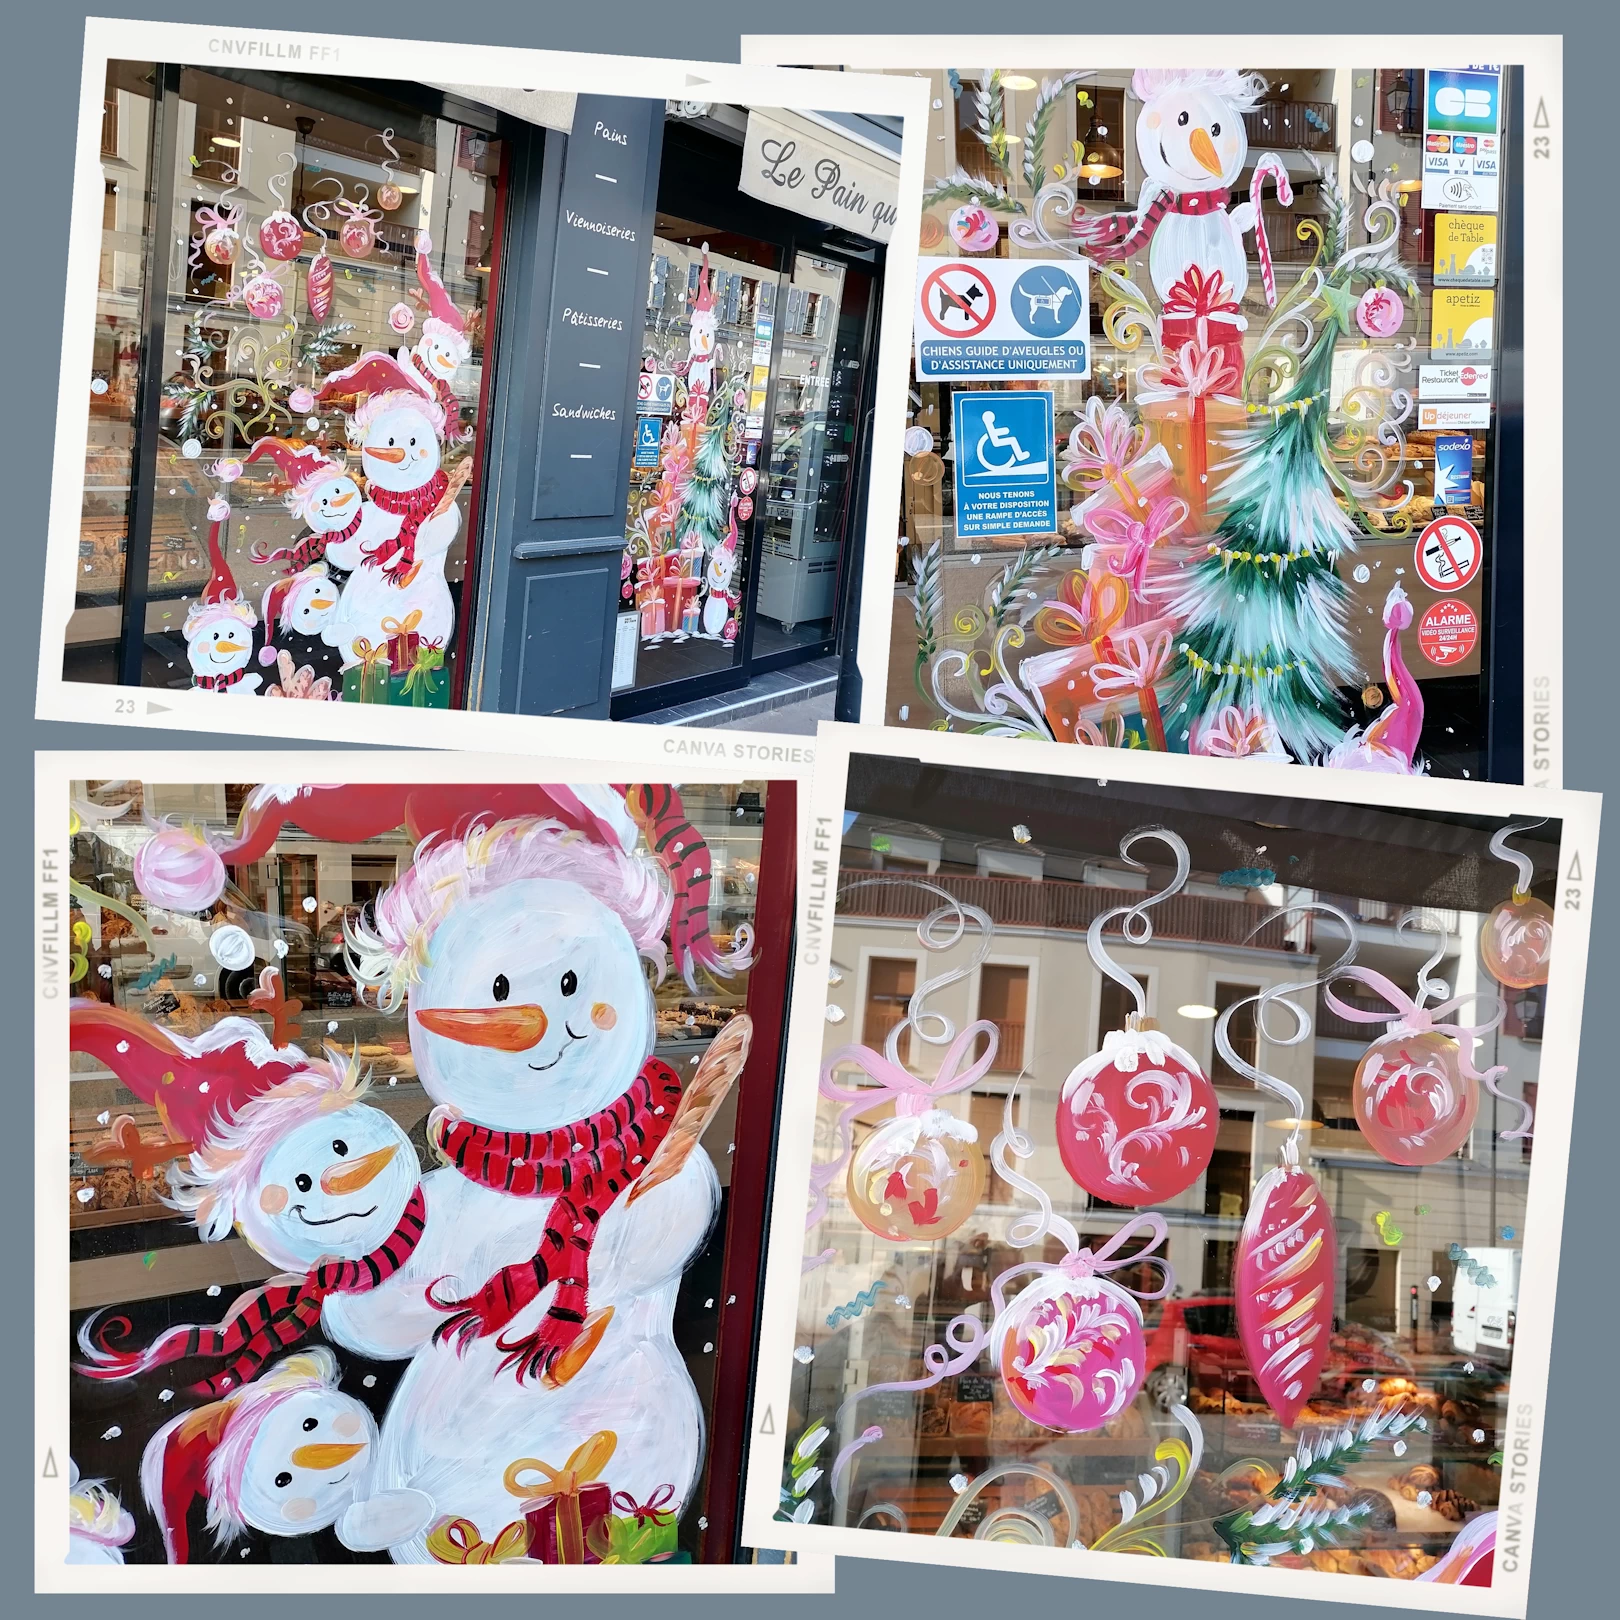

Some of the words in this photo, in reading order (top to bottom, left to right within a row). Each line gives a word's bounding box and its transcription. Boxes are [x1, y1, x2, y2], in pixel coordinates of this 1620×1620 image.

[594, 121, 628, 146] Pains
[1428, 157, 1449, 167] VISA
[1476, 159, 1497, 170] VISA
[761, 138, 806, 189] Le
[811, 158, 869, 215] Pain
[566, 209, 636, 242] Viennoiseries
[1448, 218, 1485, 233] chèque
[1448, 231, 1459, 242] de
[1460, 232, 1484, 243] Table
[1446, 293, 1481, 307] apetiz
[562, 307, 623, 331] Pâtisseries
[922, 345, 962, 357] CHIENS
[965, 345, 999, 356] GUIDE
[1002, 345, 1066, 356] D'AVEUGLES
[1068, 346, 1084, 356] OU
[931, 359, 1005, 371] D'ASSISTANCE
[1008, 359, 1077, 371] UNIQUEMENT
[1440, 369, 1459, 377] Ticket
[1459, 372, 1489, 380] Edenred
[1421, 376, 1459, 384] Restaurant
[552, 403, 616, 421] Sandwiches
[1424, 411, 1436, 422] Up
[1436, 410, 1472, 421] déjeuner
[1438, 441, 1471, 452] sodexo
[978, 491, 1002, 500] NOUS
[1003, 490, 1035, 499] TENONS
[963, 501, 970, 511] À
[971, 502, 998, 511] VOTRE
[999, 500, 1050, 509] DISPOSITION
[966, 513, 984, 521] UNE
[985, 512, 1013, 520] RAMPE
[1014, 510, 1048, 519] D'ACCÈS
[963, 523, 981, 531] SUR
[982, 522, 1011, 530] SIMPLE
[1013, 520, 1051, 529] DEMANDE
[1425, 614, 1472, 627] ALARME
[1438, 626, 1475, 636] SURVEILLANCE
